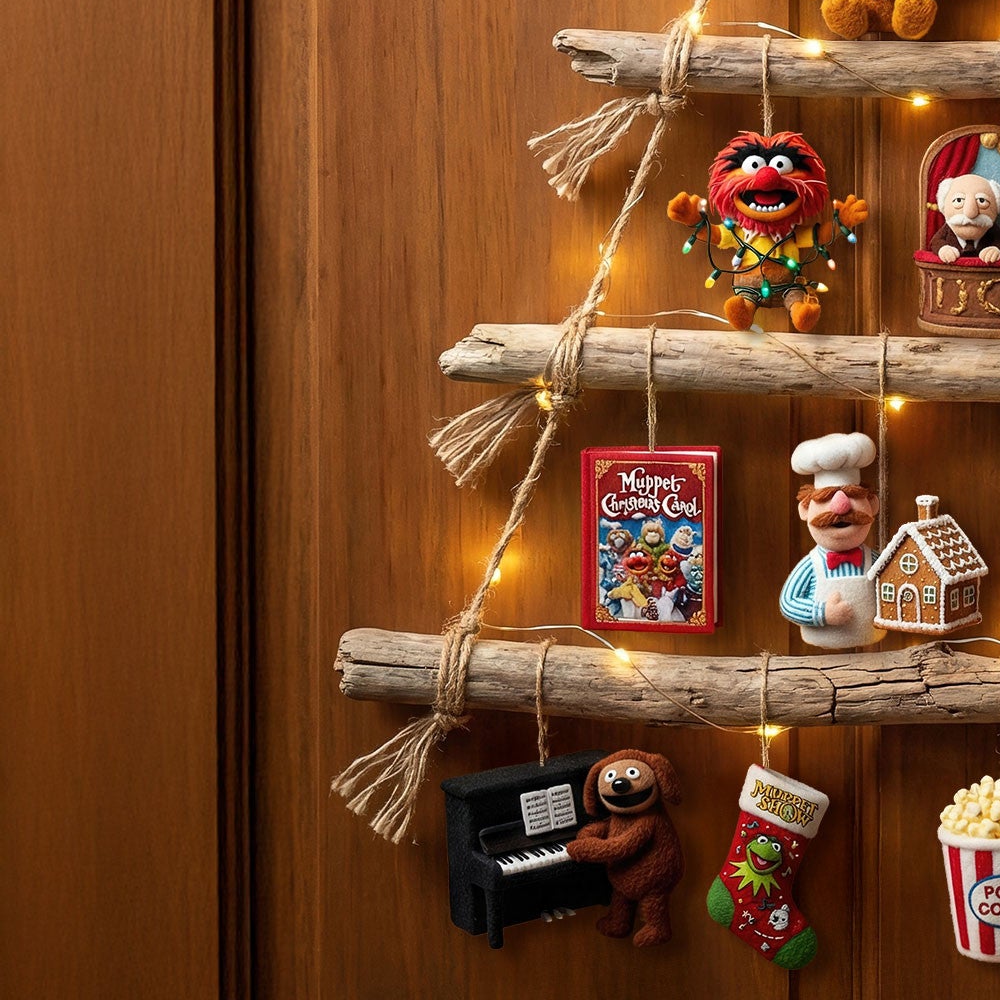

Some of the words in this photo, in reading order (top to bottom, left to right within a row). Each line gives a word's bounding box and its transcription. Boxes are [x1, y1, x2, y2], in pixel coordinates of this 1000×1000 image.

[617, 467, 686, 498] Muppet
[750, 779, 818, 817] MUPPET
[756, 795, 814, 828] SHOW
